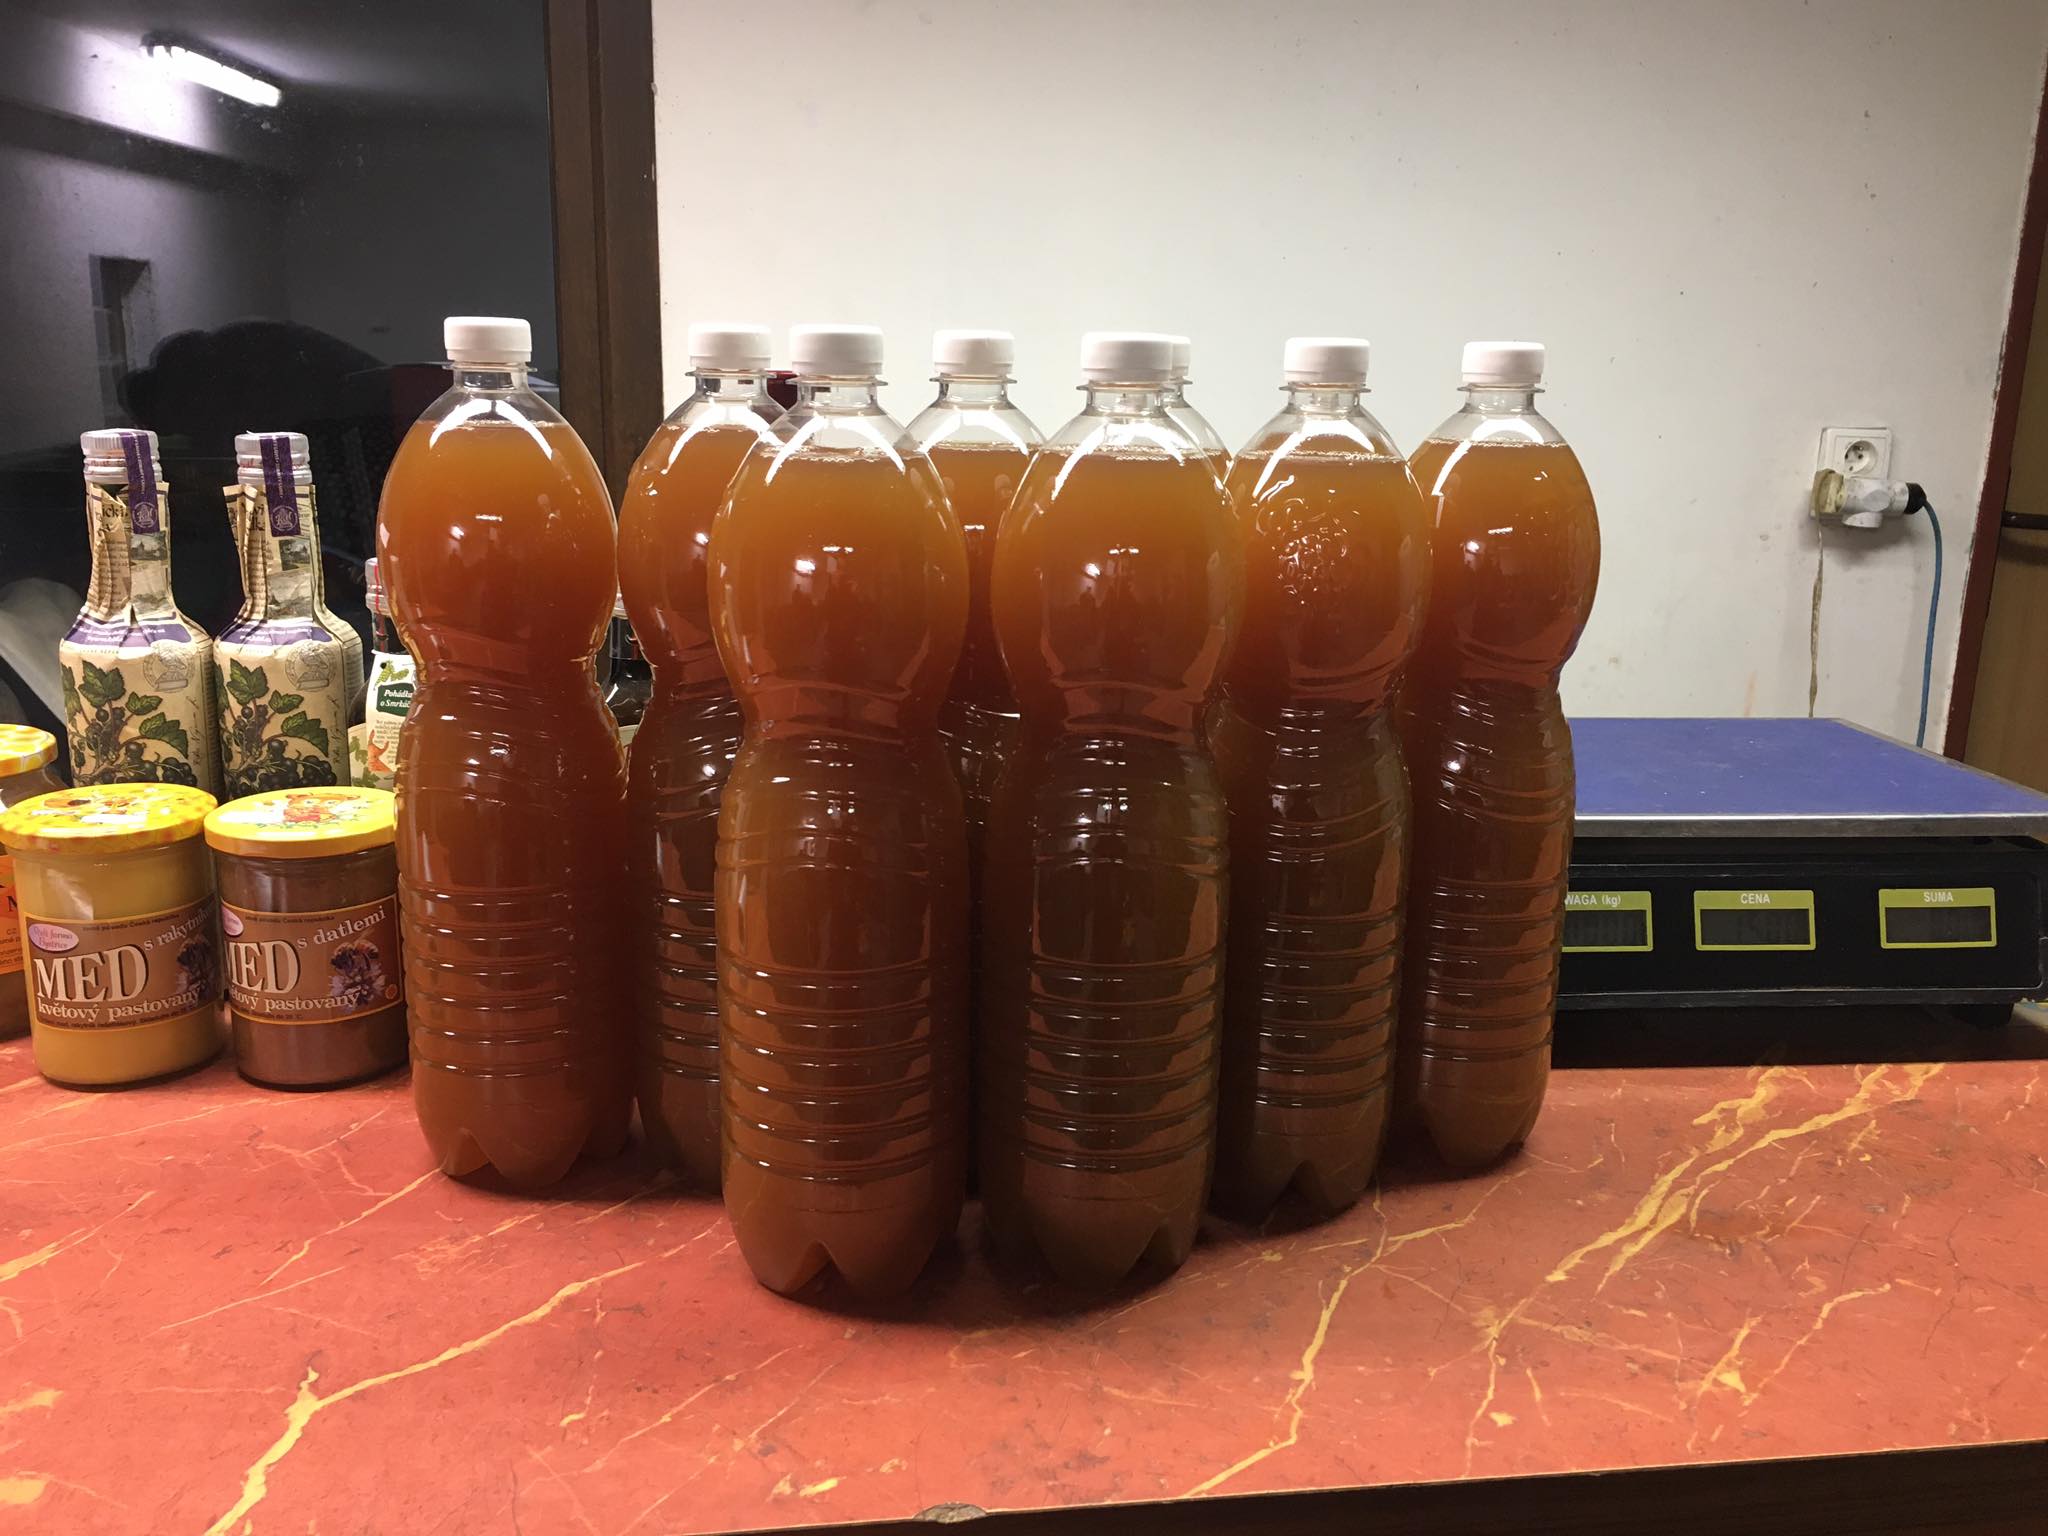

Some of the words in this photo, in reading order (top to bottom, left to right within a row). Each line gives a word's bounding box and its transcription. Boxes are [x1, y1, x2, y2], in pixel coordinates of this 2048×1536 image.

[1565, 894, 1597, 905] WAGA
[1601, 894, 1621, 907] (kg)
[1740, 893, 1770, 904] CENA
[1923, 891, 1953, 903] SUMA
[296, 937, 307, 950] s
[313, 905, 387, 946] datlemi
[144, 939, 154, 951] s
[33, 944, 148, 1003] MED
[38, 996, 101, 1022] květový
